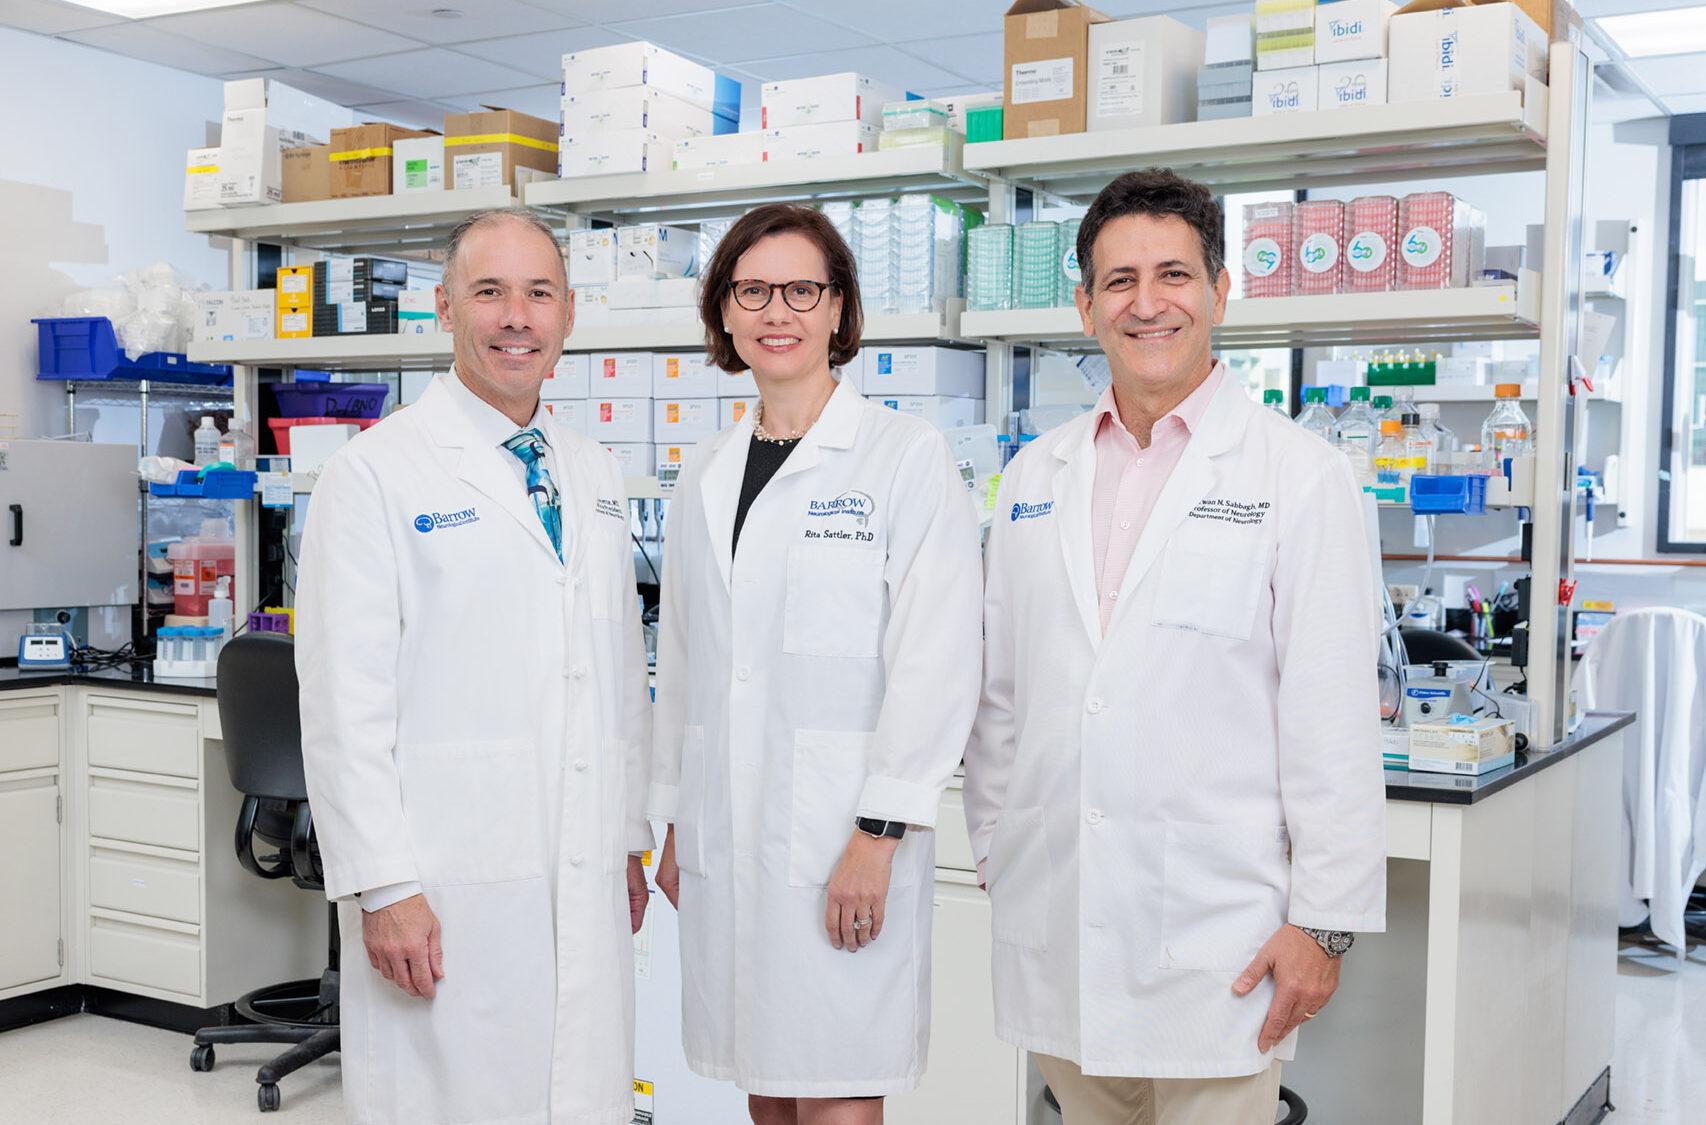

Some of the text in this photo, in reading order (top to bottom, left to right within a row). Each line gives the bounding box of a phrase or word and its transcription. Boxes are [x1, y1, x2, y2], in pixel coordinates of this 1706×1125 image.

[1333, 21, 1362, 37] ibidi
[1441, 37, 1454, 69] ibidi
[1272, 95, 1299, 108] ibidi
[1339, 88, 1366, 102] ibidi
[809, 497, 867, 510] BARROW
[1020, 501, 1055, 514] Barrow
[432, 507, 476, 524] Barrow
[1189, 511, 1224, 520] Department
[1233, 517, 1263, 525] Neurology
[1231, 509, 1265, 518] Neurology
[804, 529, 874, 541] Rita Sattler, PhD
